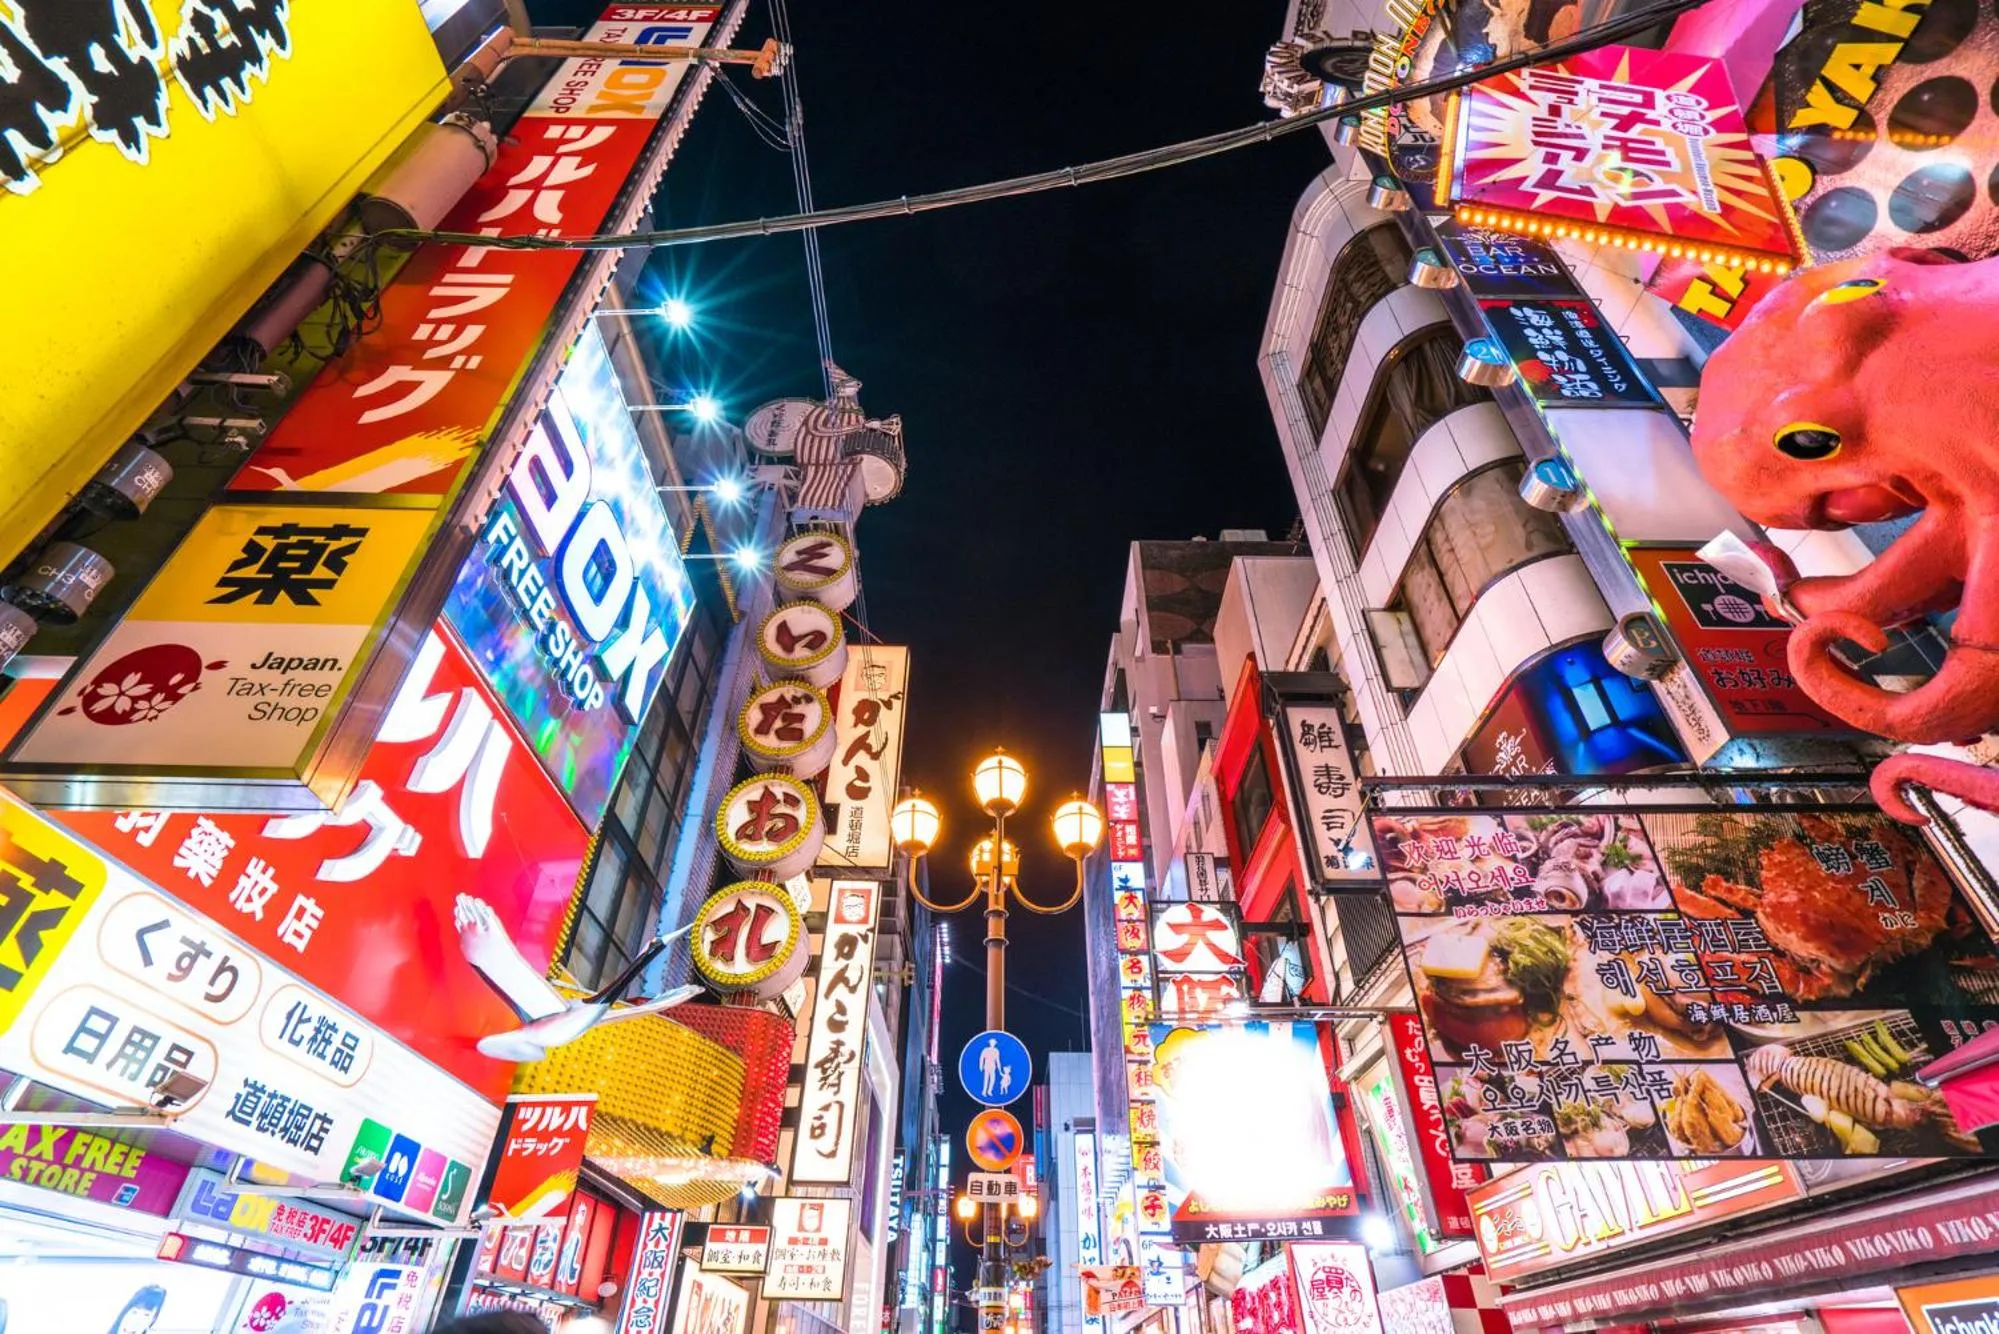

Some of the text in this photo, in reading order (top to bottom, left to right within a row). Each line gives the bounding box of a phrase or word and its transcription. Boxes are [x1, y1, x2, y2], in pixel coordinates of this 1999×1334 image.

[611, 8, 714, 21] 3F/4F
[548, 79, 590, 115] SHOP
[1458, 263, 1559, 274] OCEAN
[1467, 245, 1525, 257] BAR
[351, 125, 617, 425] ツルハドラッグ
[204, 522, 372, 607] 薬
[485, 512, 602, 712] FREE SHOP
[250, 651, 344, 677] Japan.
[225, 677, 333, 699] Tax-free
[247, 701, 320, 727] Shop
[841, 690, 905, 801] がんこ
[843, 805, 863, 858] 道頓堀店
[1398, 831, 1522, 869] 欢迎光临
[1416, 867, 1538, 898] 어서오세요
[1452, 896, 1549, 919] いらっしゃいませ
[1878, 911, 1919, 930] かに
[134, 918, 241, 1005] くすり
[61, 1005, 197, 1089] 日用品
[277, 1000, 362, 1077] 化粧品
[1462, 1031, 1662, 1076] 大阪名产物
[1481, 1069, 1675, 1113] 오오사까특산품
[224, 1076, 335, 1158] 道頓堀店
[516, 1105, 589, 1132] ツルハ
[1487, 1118, 1556, 1140] 大阪名物
[62, 1132, 147, 1180] FREE
[507, 1136, 571, 1157] ドラッグ
[9, 1157, 98, 1197] STORE
[969, 1179, 1019, 1197] 自動車
[303, 1214, 357, 1251] 3F/4F
[1773, 1244, 1846, 1277] NIKO-NIKO
[1844, 1226, 1935, 1261] NIKO-NIKO
[629, 1221, 671, 1330] 大阪紀念
